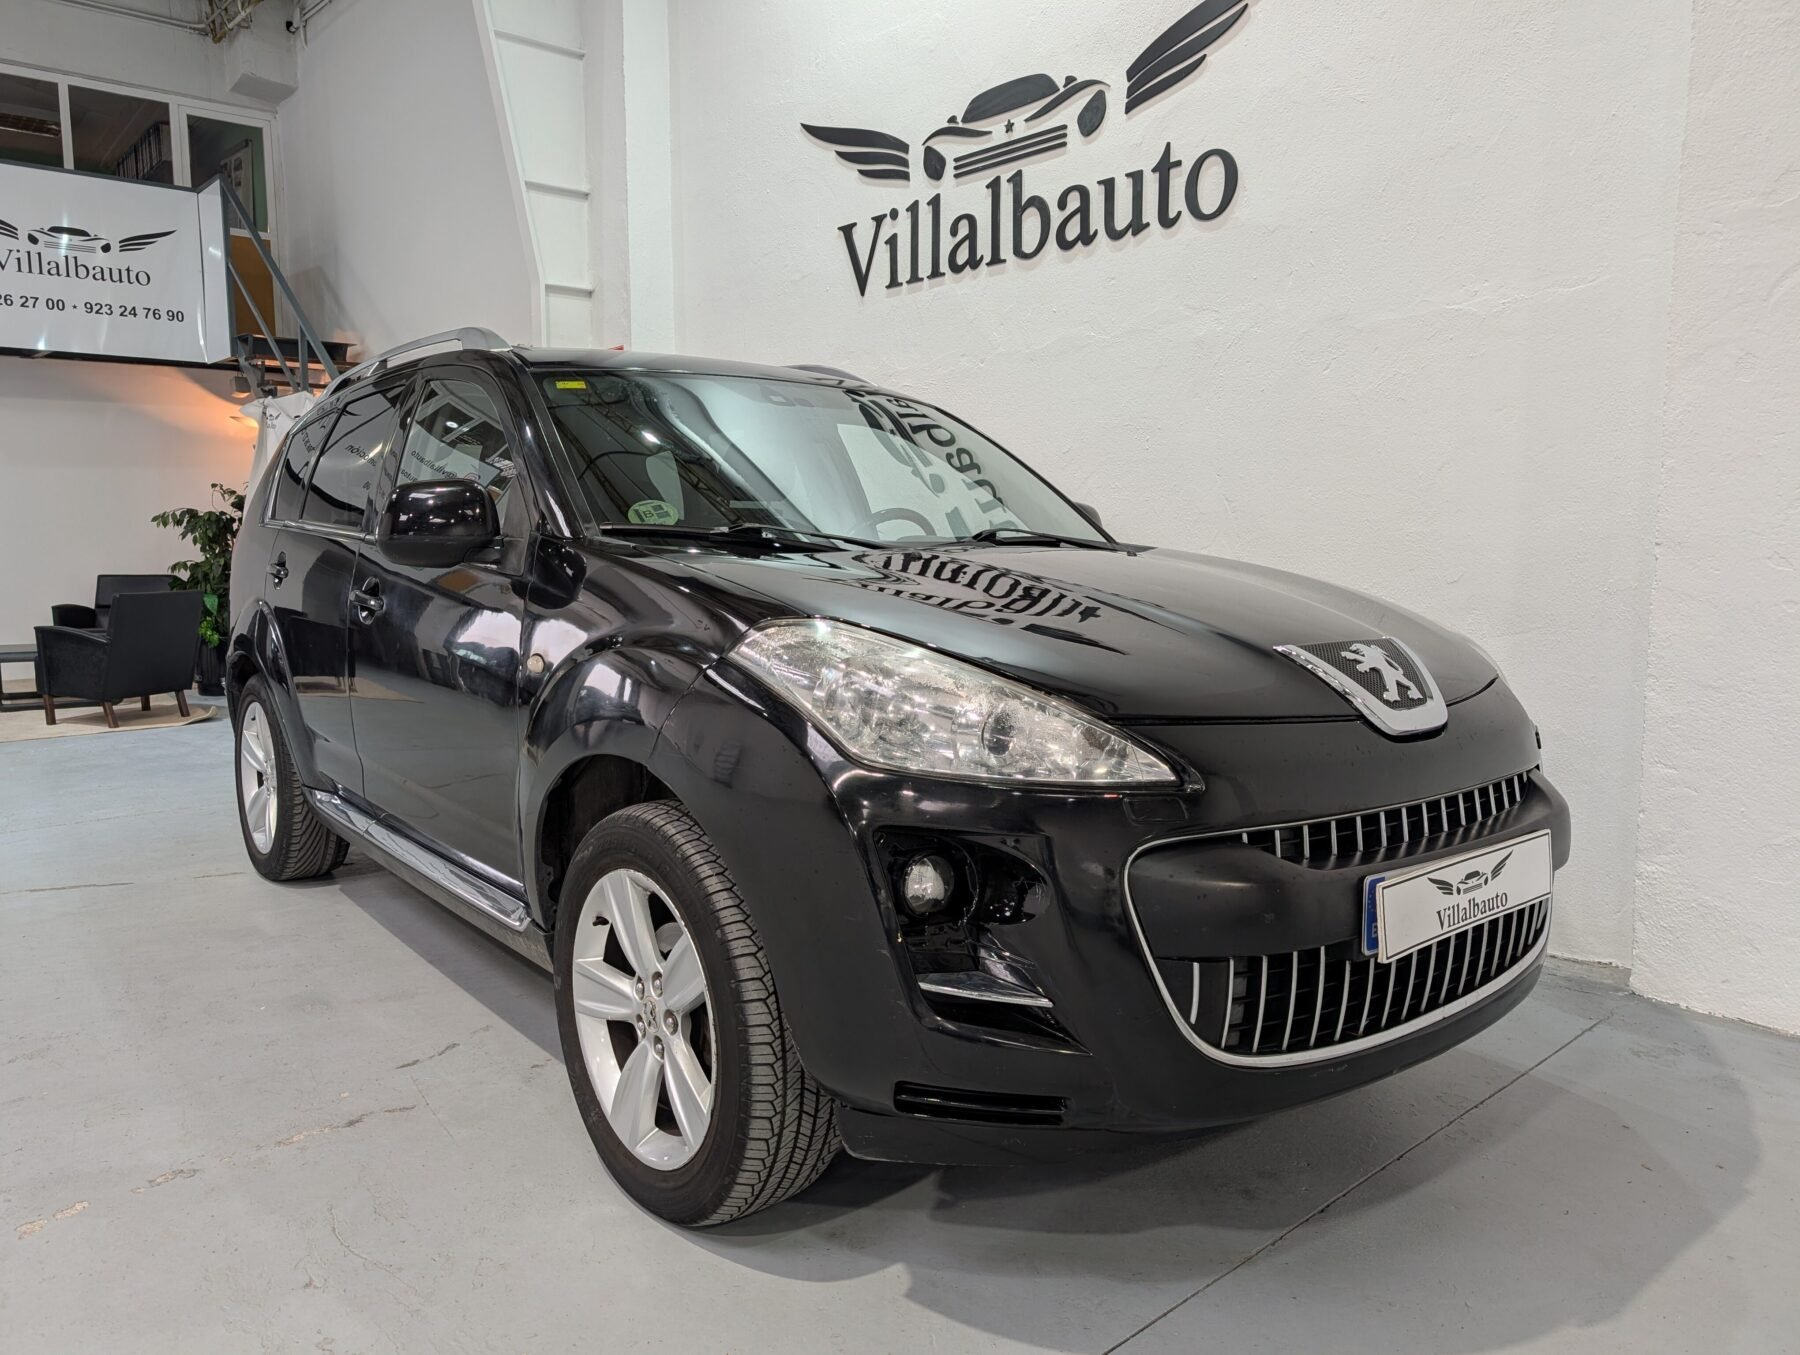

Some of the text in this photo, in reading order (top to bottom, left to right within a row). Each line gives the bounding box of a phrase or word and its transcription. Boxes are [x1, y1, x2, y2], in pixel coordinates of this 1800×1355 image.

[837, 141, 1239, 297] Villalbauto
[0, 249, 152, 287] Villalbauto
[0, 293, 185, 323] 6 27 00 923 24 76 90
[1436, 891, 1508, 931] Villalbauto
